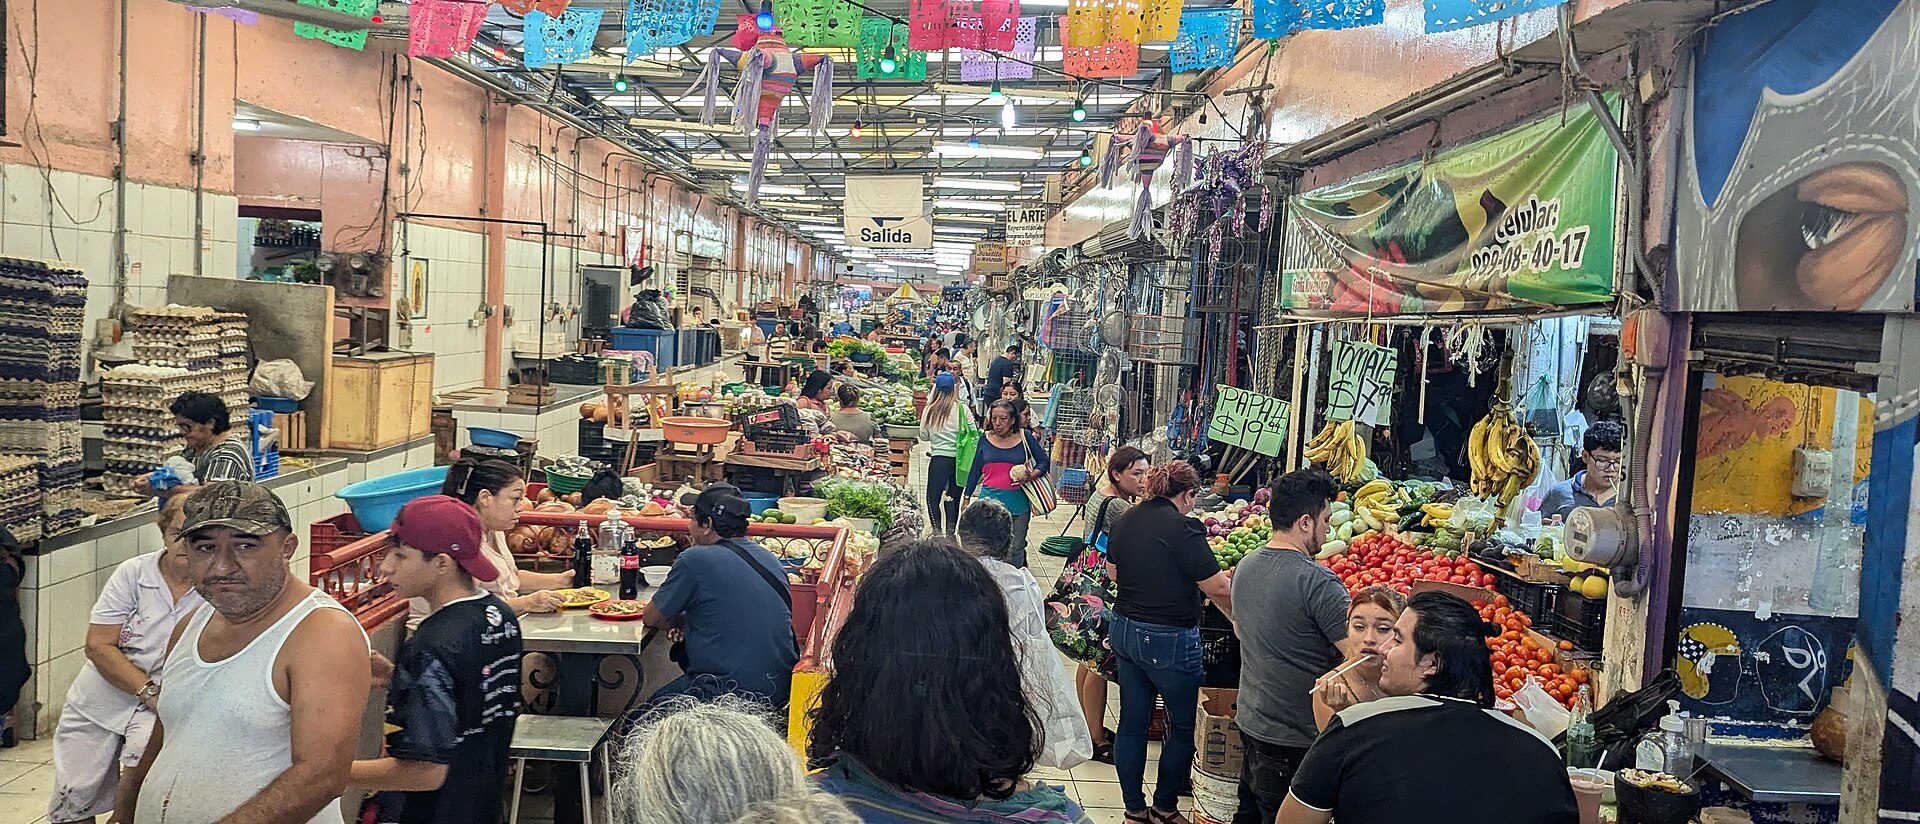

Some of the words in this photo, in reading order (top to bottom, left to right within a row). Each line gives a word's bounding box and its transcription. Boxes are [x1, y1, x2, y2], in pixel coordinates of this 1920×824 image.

[1007, 209, 1017, 222] EL
[1020, 209, 1045, 222] ARTE
[860, 227, 912, 244] Salida
